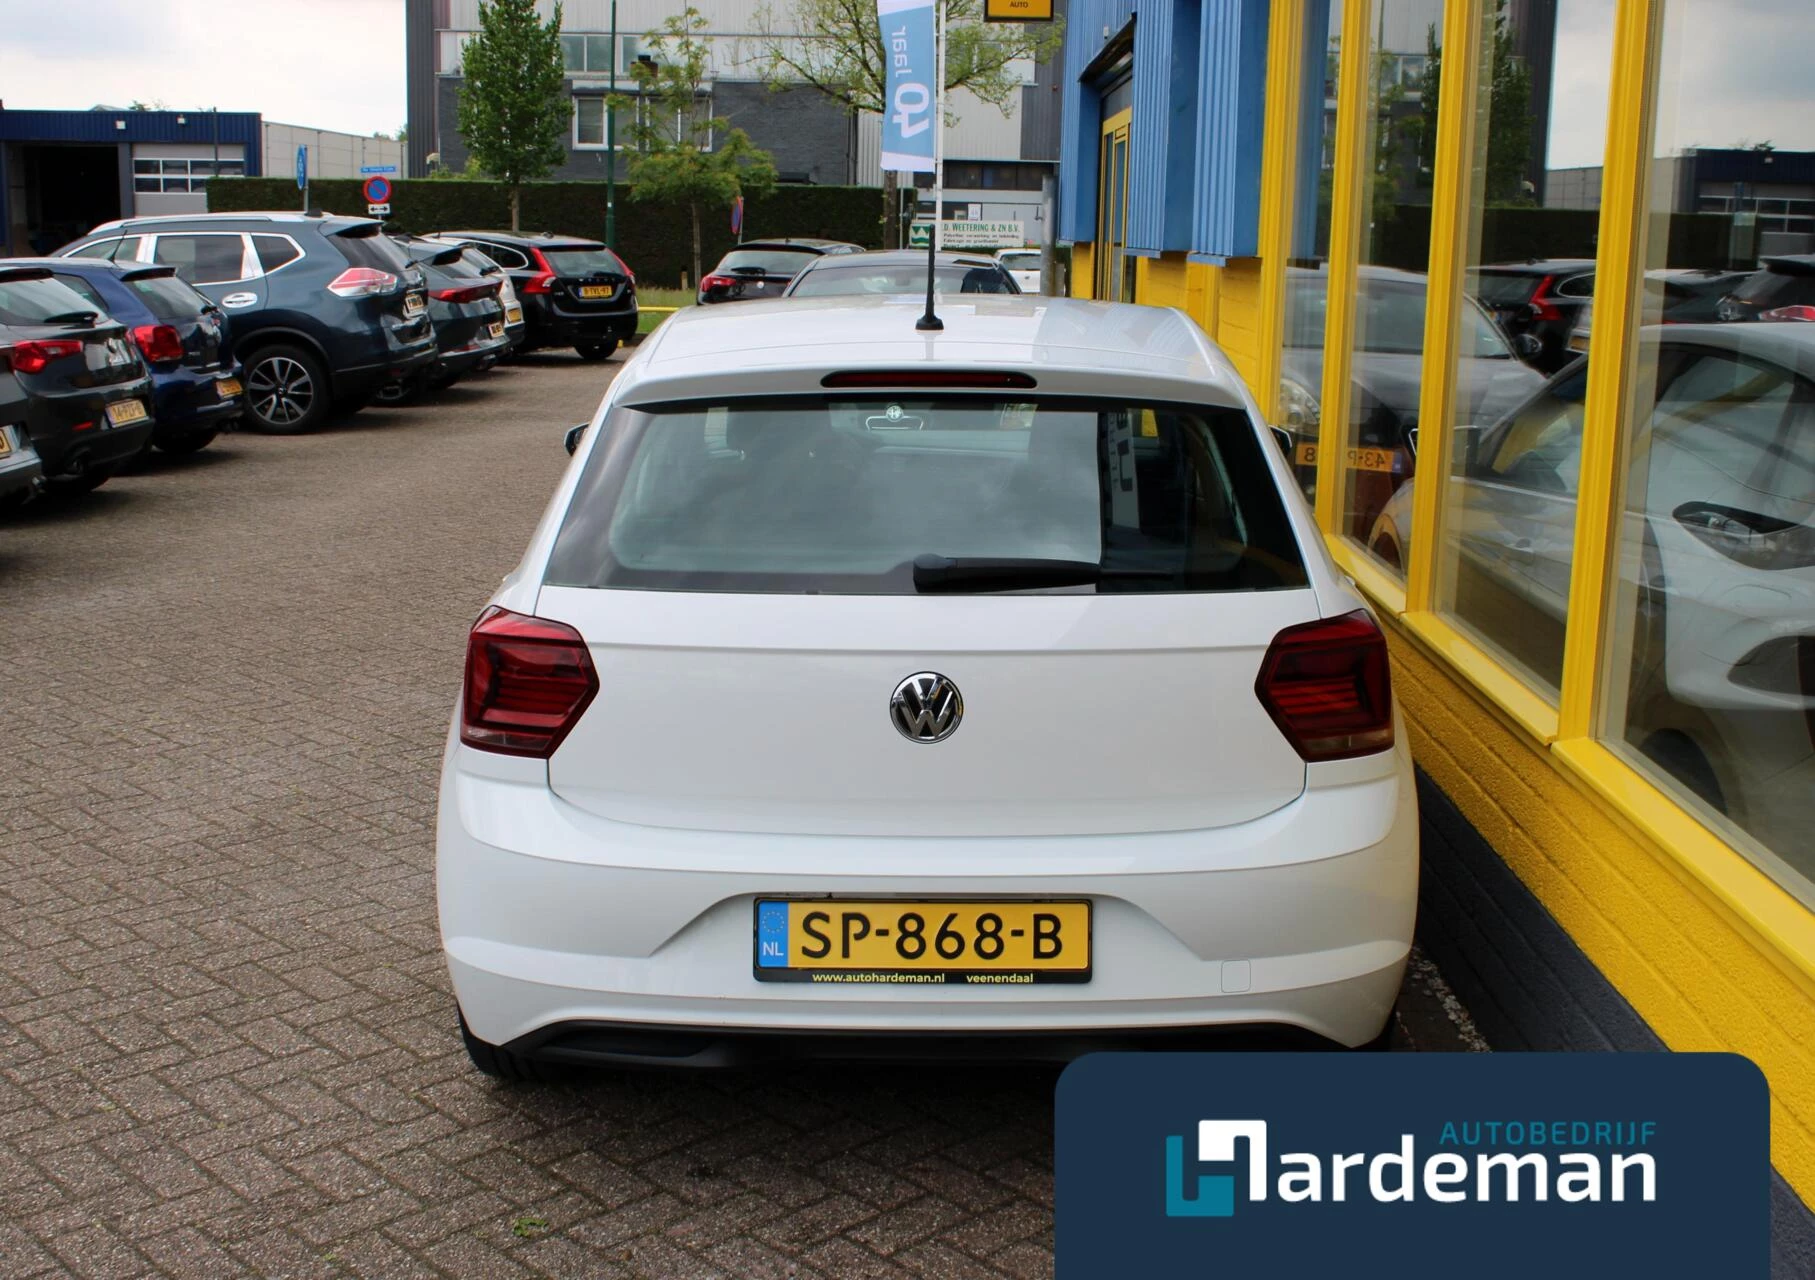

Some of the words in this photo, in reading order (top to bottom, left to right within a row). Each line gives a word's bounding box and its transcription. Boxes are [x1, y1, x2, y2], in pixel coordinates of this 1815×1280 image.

[952, 223, 989, 232] WEETERING
[998, 223, 1007, 232] ZN
[763, 942, 783, 956] NL
[801, 911, 1063, 960] SP-868-B
[812, 972, 945, 983] www.autohardeman.nl
[966, 973, 1034, 983] veenendaal
